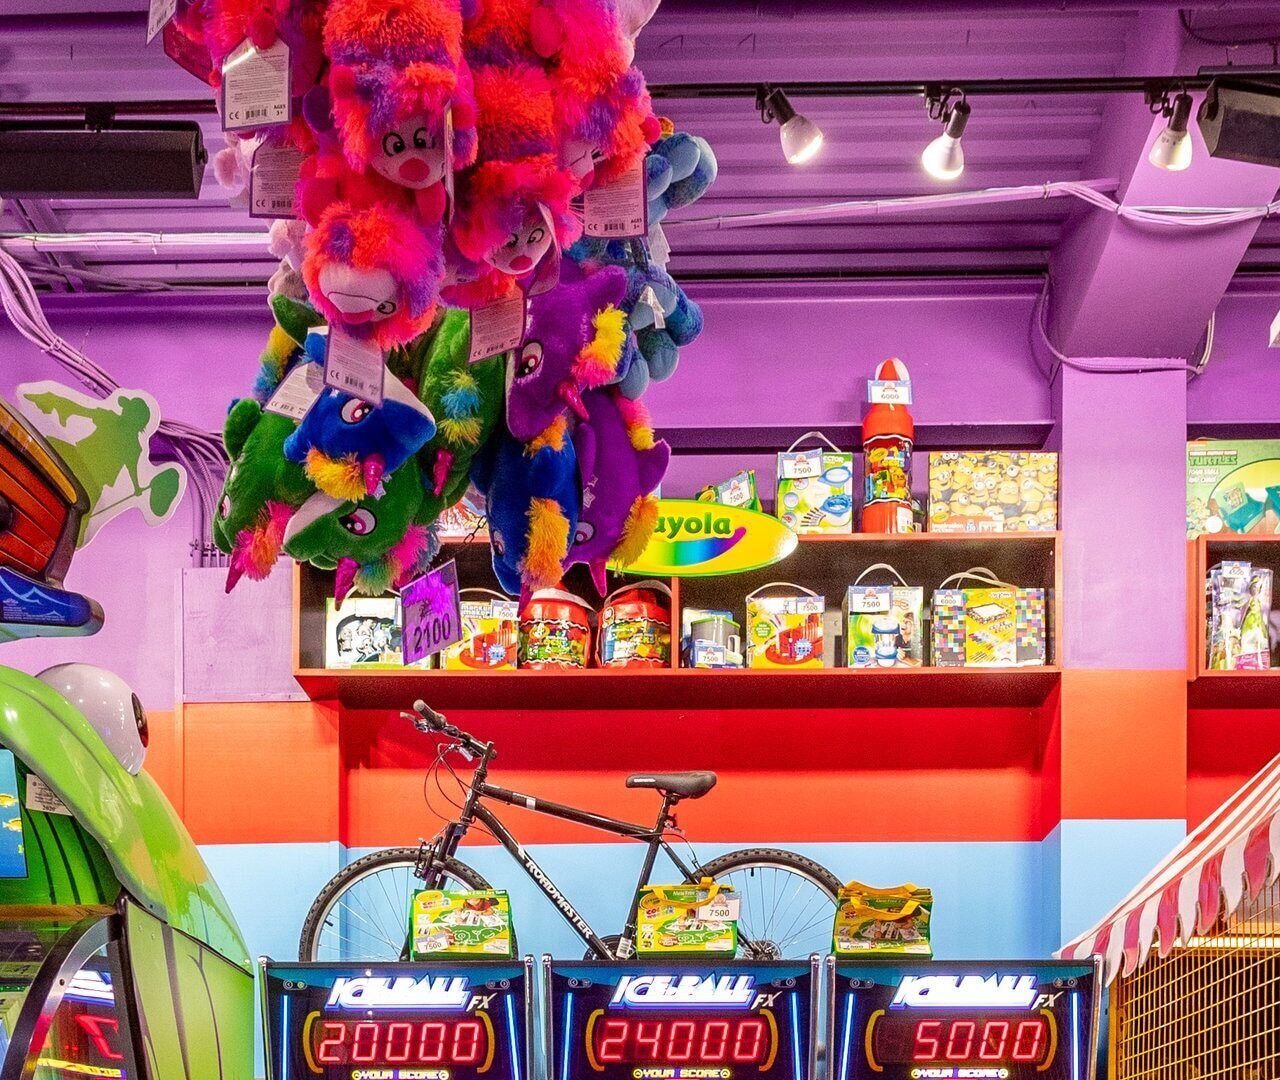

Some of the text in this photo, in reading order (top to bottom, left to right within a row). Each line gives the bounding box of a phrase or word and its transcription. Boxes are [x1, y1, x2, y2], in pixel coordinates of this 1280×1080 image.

[793, 466, 812, 475] 7500
[654, 511, 732, 540] ayola
[413, 613, 451, 655] 2100
[703, 655, 719, 663] 7500
[525, 860, 593, 940] ROADMASTER
[709, 909, 730, 918] 7500
[423, 942, 442, 951] 7500
[467, 992, 497, 1012] FX
[750, 991, 782, 1010] FX
[1032, 990, 1065, 1010] FX
[319, 1021, 482, 1063] 20000
[600, 1020, 765, 1061] 24000
[913, 1020, 1045, 1061] 5000
[362, 1069, 440, 1080] YOUR SCORE
[643, 1069, 720, 1078] YOUR SCORE
